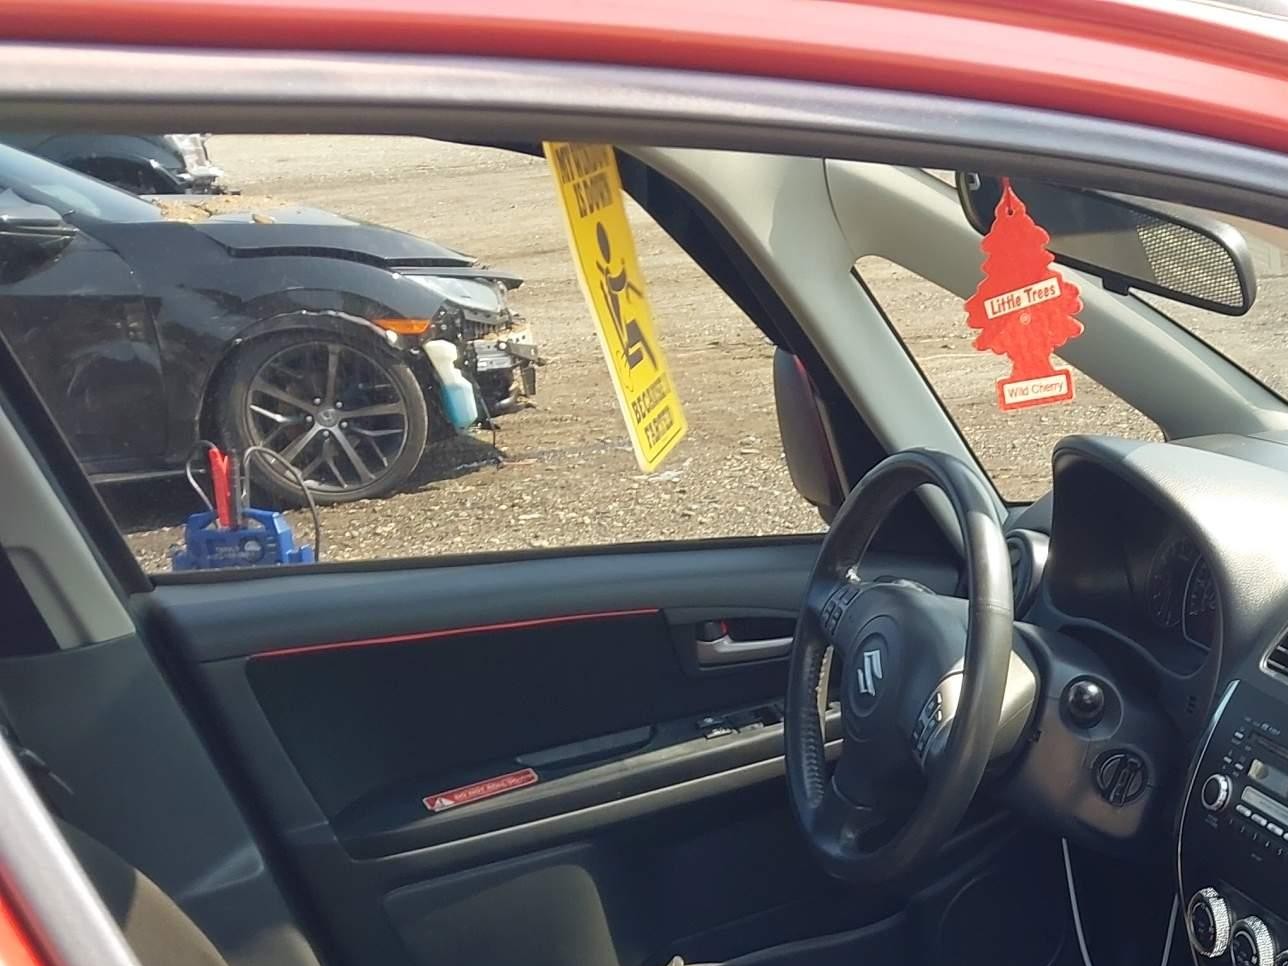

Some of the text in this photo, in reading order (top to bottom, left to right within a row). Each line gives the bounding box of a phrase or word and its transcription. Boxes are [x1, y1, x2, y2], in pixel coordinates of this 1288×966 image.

[989, 284, 1056, 316] Little Trees
[1007, 380, 1064, 398] Wild Cherry
